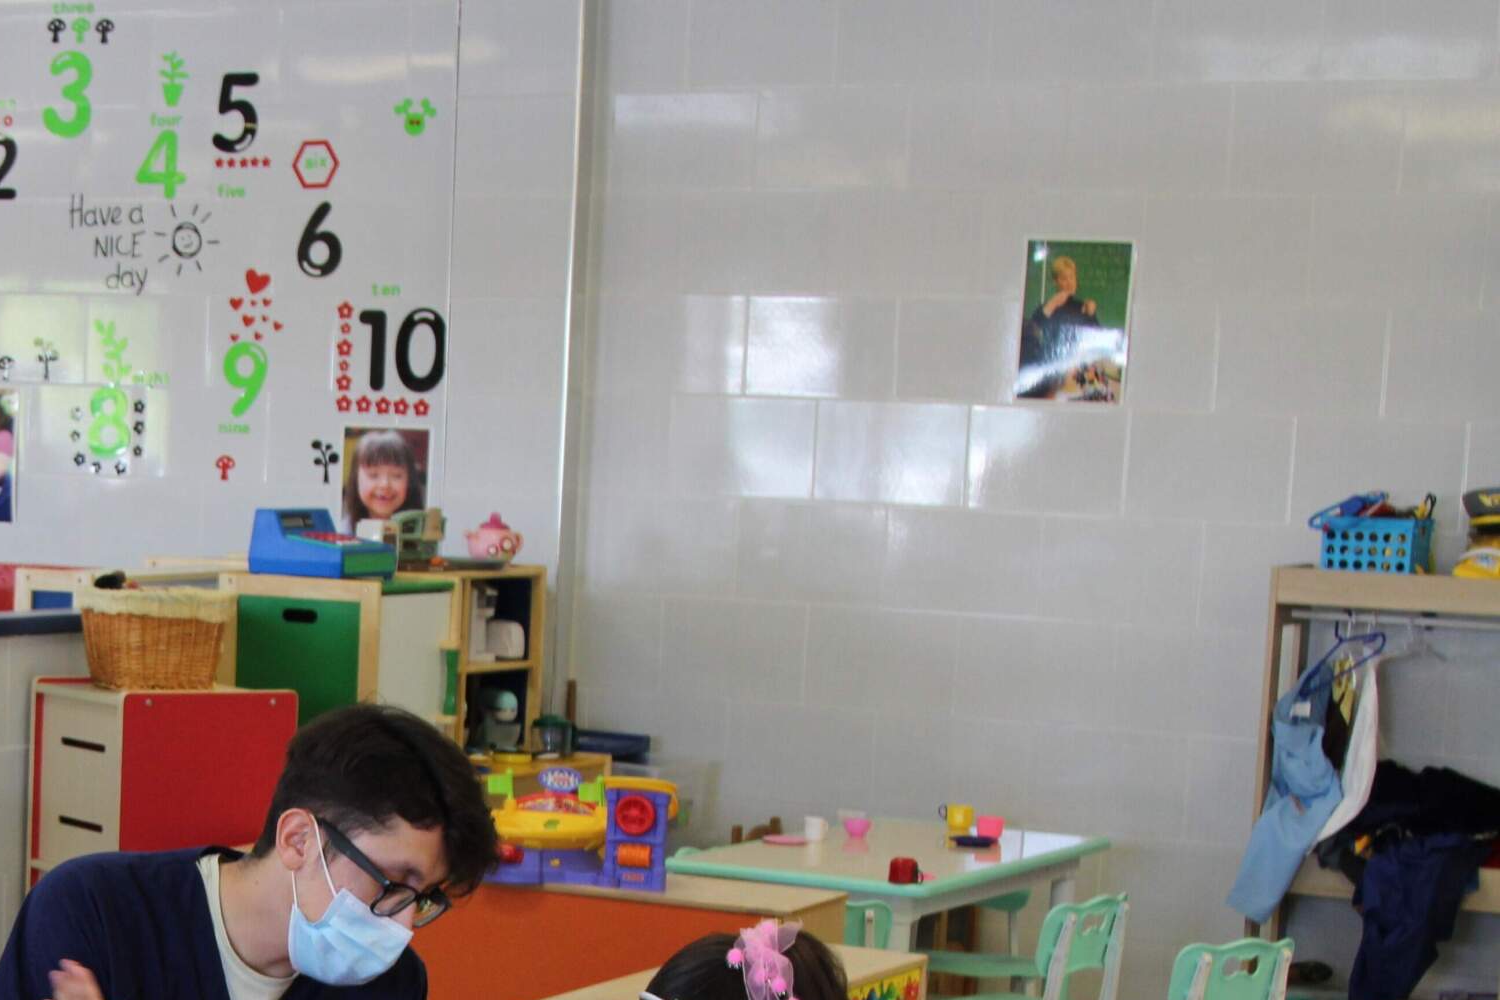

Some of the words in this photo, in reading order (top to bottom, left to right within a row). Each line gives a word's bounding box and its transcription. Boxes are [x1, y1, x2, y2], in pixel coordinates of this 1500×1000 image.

[52, 2, 95, 14] three
[42, 50, 93, 138] 3
[150, 112, 183, 127] four
[212, 72, 260, 153] 5
[134, 130, 187, 199] 4
[304, 156, 328, 170] six
[217, 185, 246, 198] five
[68, 195, 123, 229] Have
[128, 204, 145, 226] a
[93, 231, 147, 259] NICE
[297, 201, 342, 278] 6
[105, 263, 149, 296] day
[370, 282, 401, 297] ten
[359, 307, 447, 393] 10
[223, 341, 268, 417] 9
[87, 386, 132, 459] 8
[217, 423, 251, 434] nine
